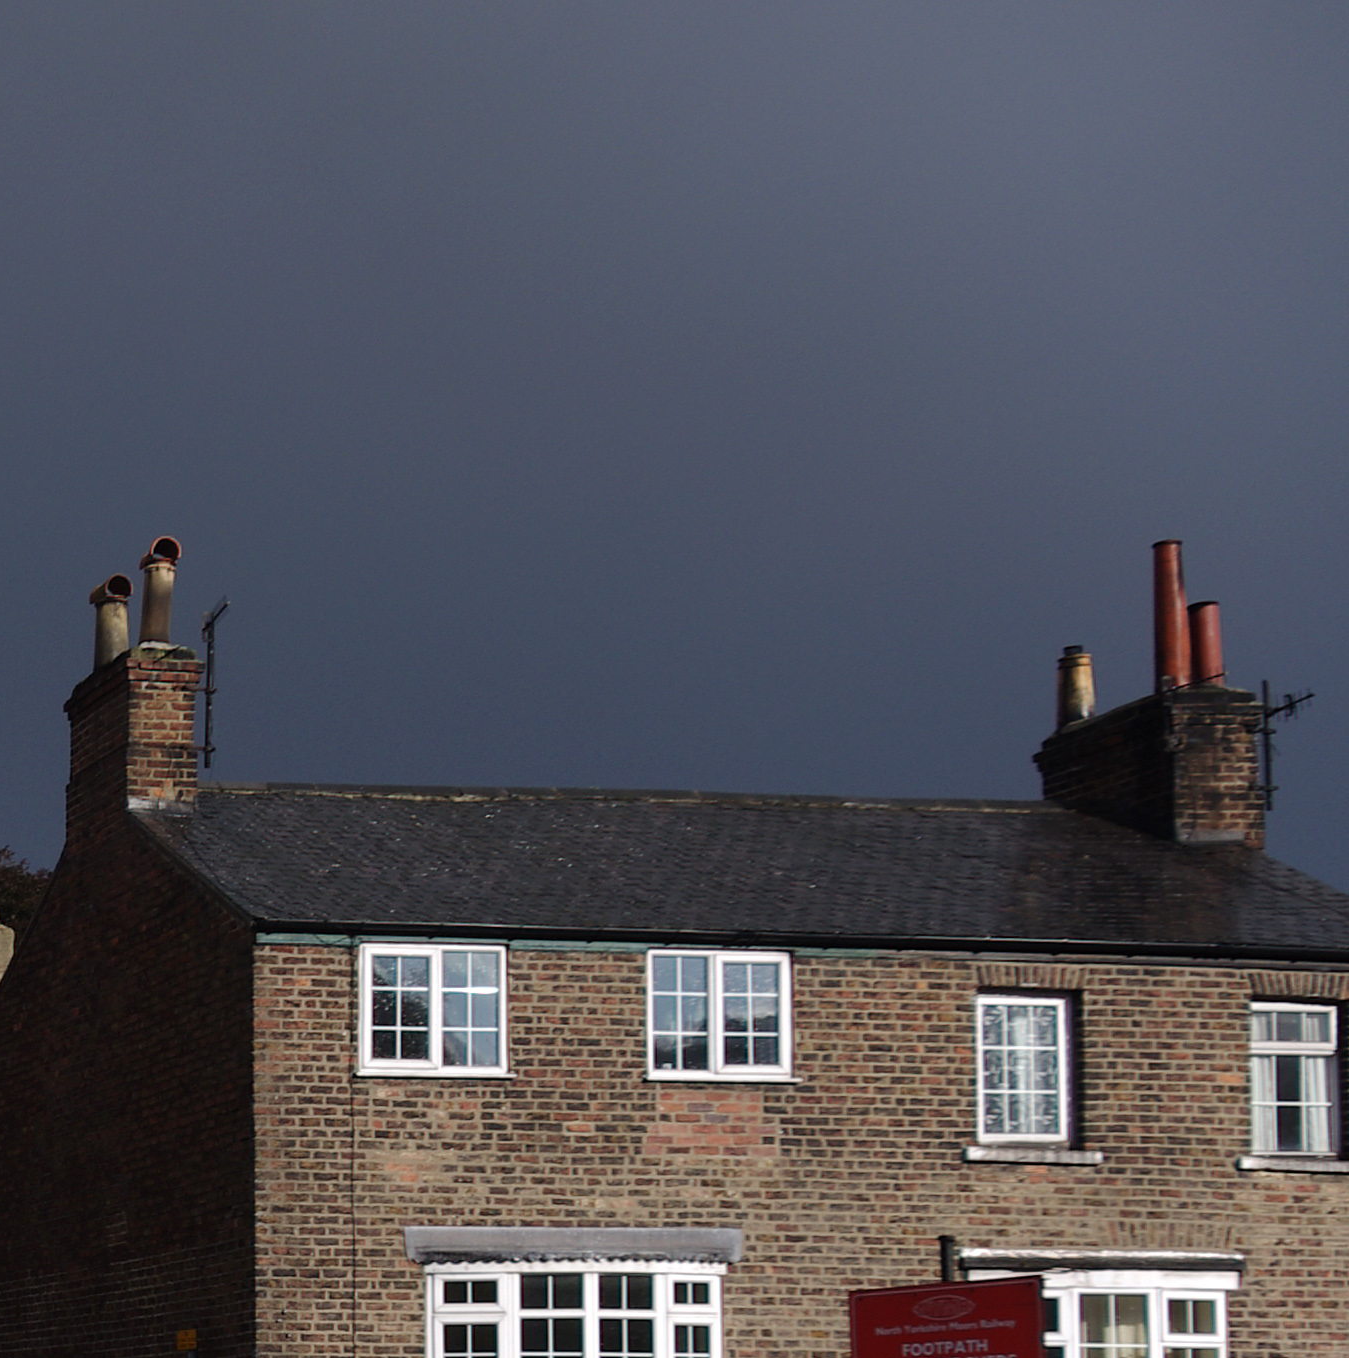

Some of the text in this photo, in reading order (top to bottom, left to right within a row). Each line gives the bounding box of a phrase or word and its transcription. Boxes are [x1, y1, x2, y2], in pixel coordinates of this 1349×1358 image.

[875, 1318, 1016, 1336] North Yorkshire Moors Railway
[902, 1339, 989, 1357] FOOTPATH
